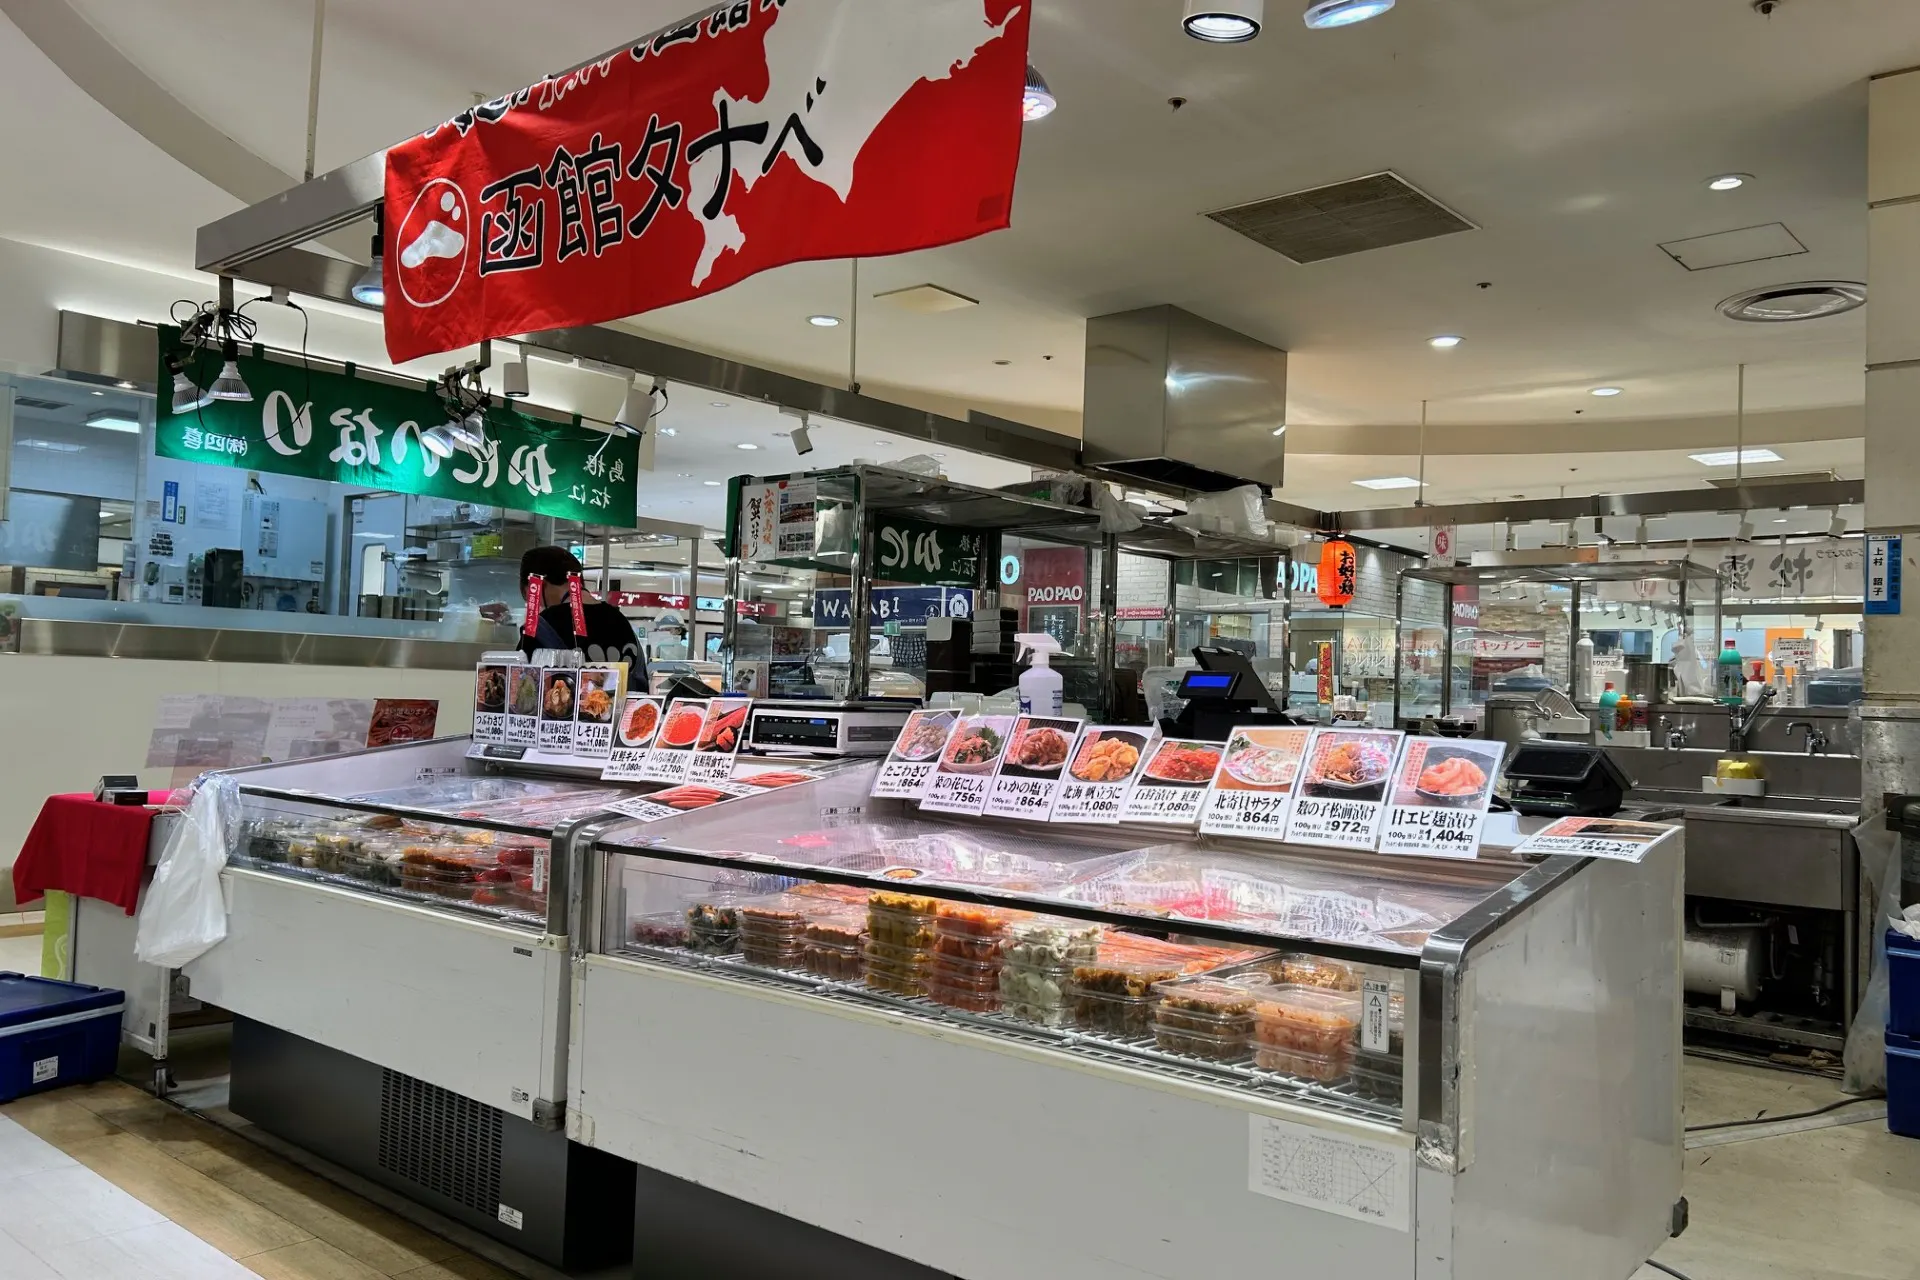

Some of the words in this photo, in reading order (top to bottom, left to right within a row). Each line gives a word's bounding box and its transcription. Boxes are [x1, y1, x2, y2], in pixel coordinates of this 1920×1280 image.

[479, 76, 826, 278] 函館タナベ
[1873, 547, 1884, 566] 上村
[1027, 585, 1083, 602] PAOPAO
[883, 764, 932, 778] たこわさび
[934, 776, 985, 792] 菜の花にしん
[997, 779, 1055, 797] いかの塩辛
[954, 792, 982, 804] 756円
[1019, 796, 1049, 808] 864円
[1134, 788, 1178, 801] 石狩漬け
[1084, 800, 1119, 812] 1,080円
[1158, 802, 1196, 812] 1,080円
[1214, 793, 1284, 813] 北寄貝サラダ
[1242, 810, 1279, 825] 864円
[1296, 799, 1377, 823] 数の子松前漬け
[1391, 808, 1478, 830] 甘エビ麹漬け
[1330, 820, 1370, 834] 972円
[1425, 828, 1474, 843] 1,404円
